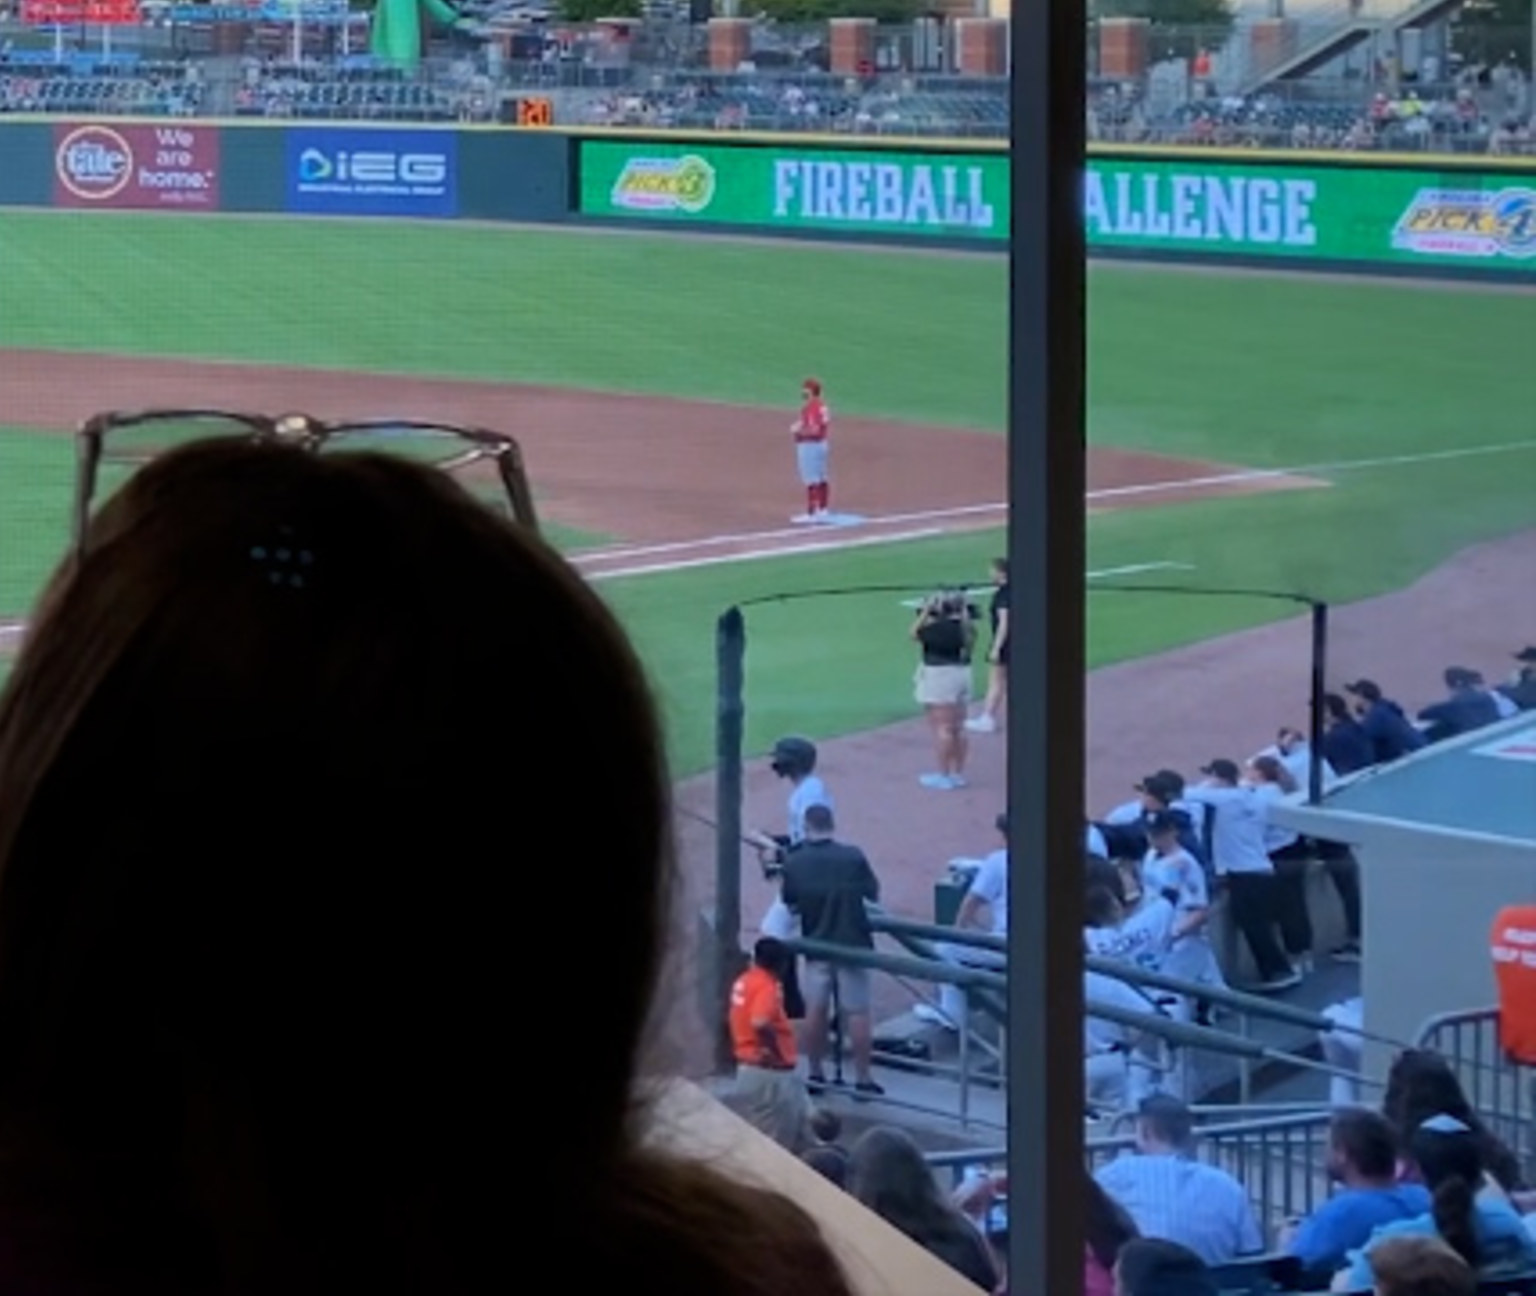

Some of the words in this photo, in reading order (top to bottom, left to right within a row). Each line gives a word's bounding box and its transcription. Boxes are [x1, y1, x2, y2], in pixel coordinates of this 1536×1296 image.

[155, 127, 194, 147] We
[156, 149, 193, 167] are
[773, 158, 994, 228] FIREBALL
[1084, 169, 1318, 246] ALLENGE
[1409, 207, 1484, 232] PICK
